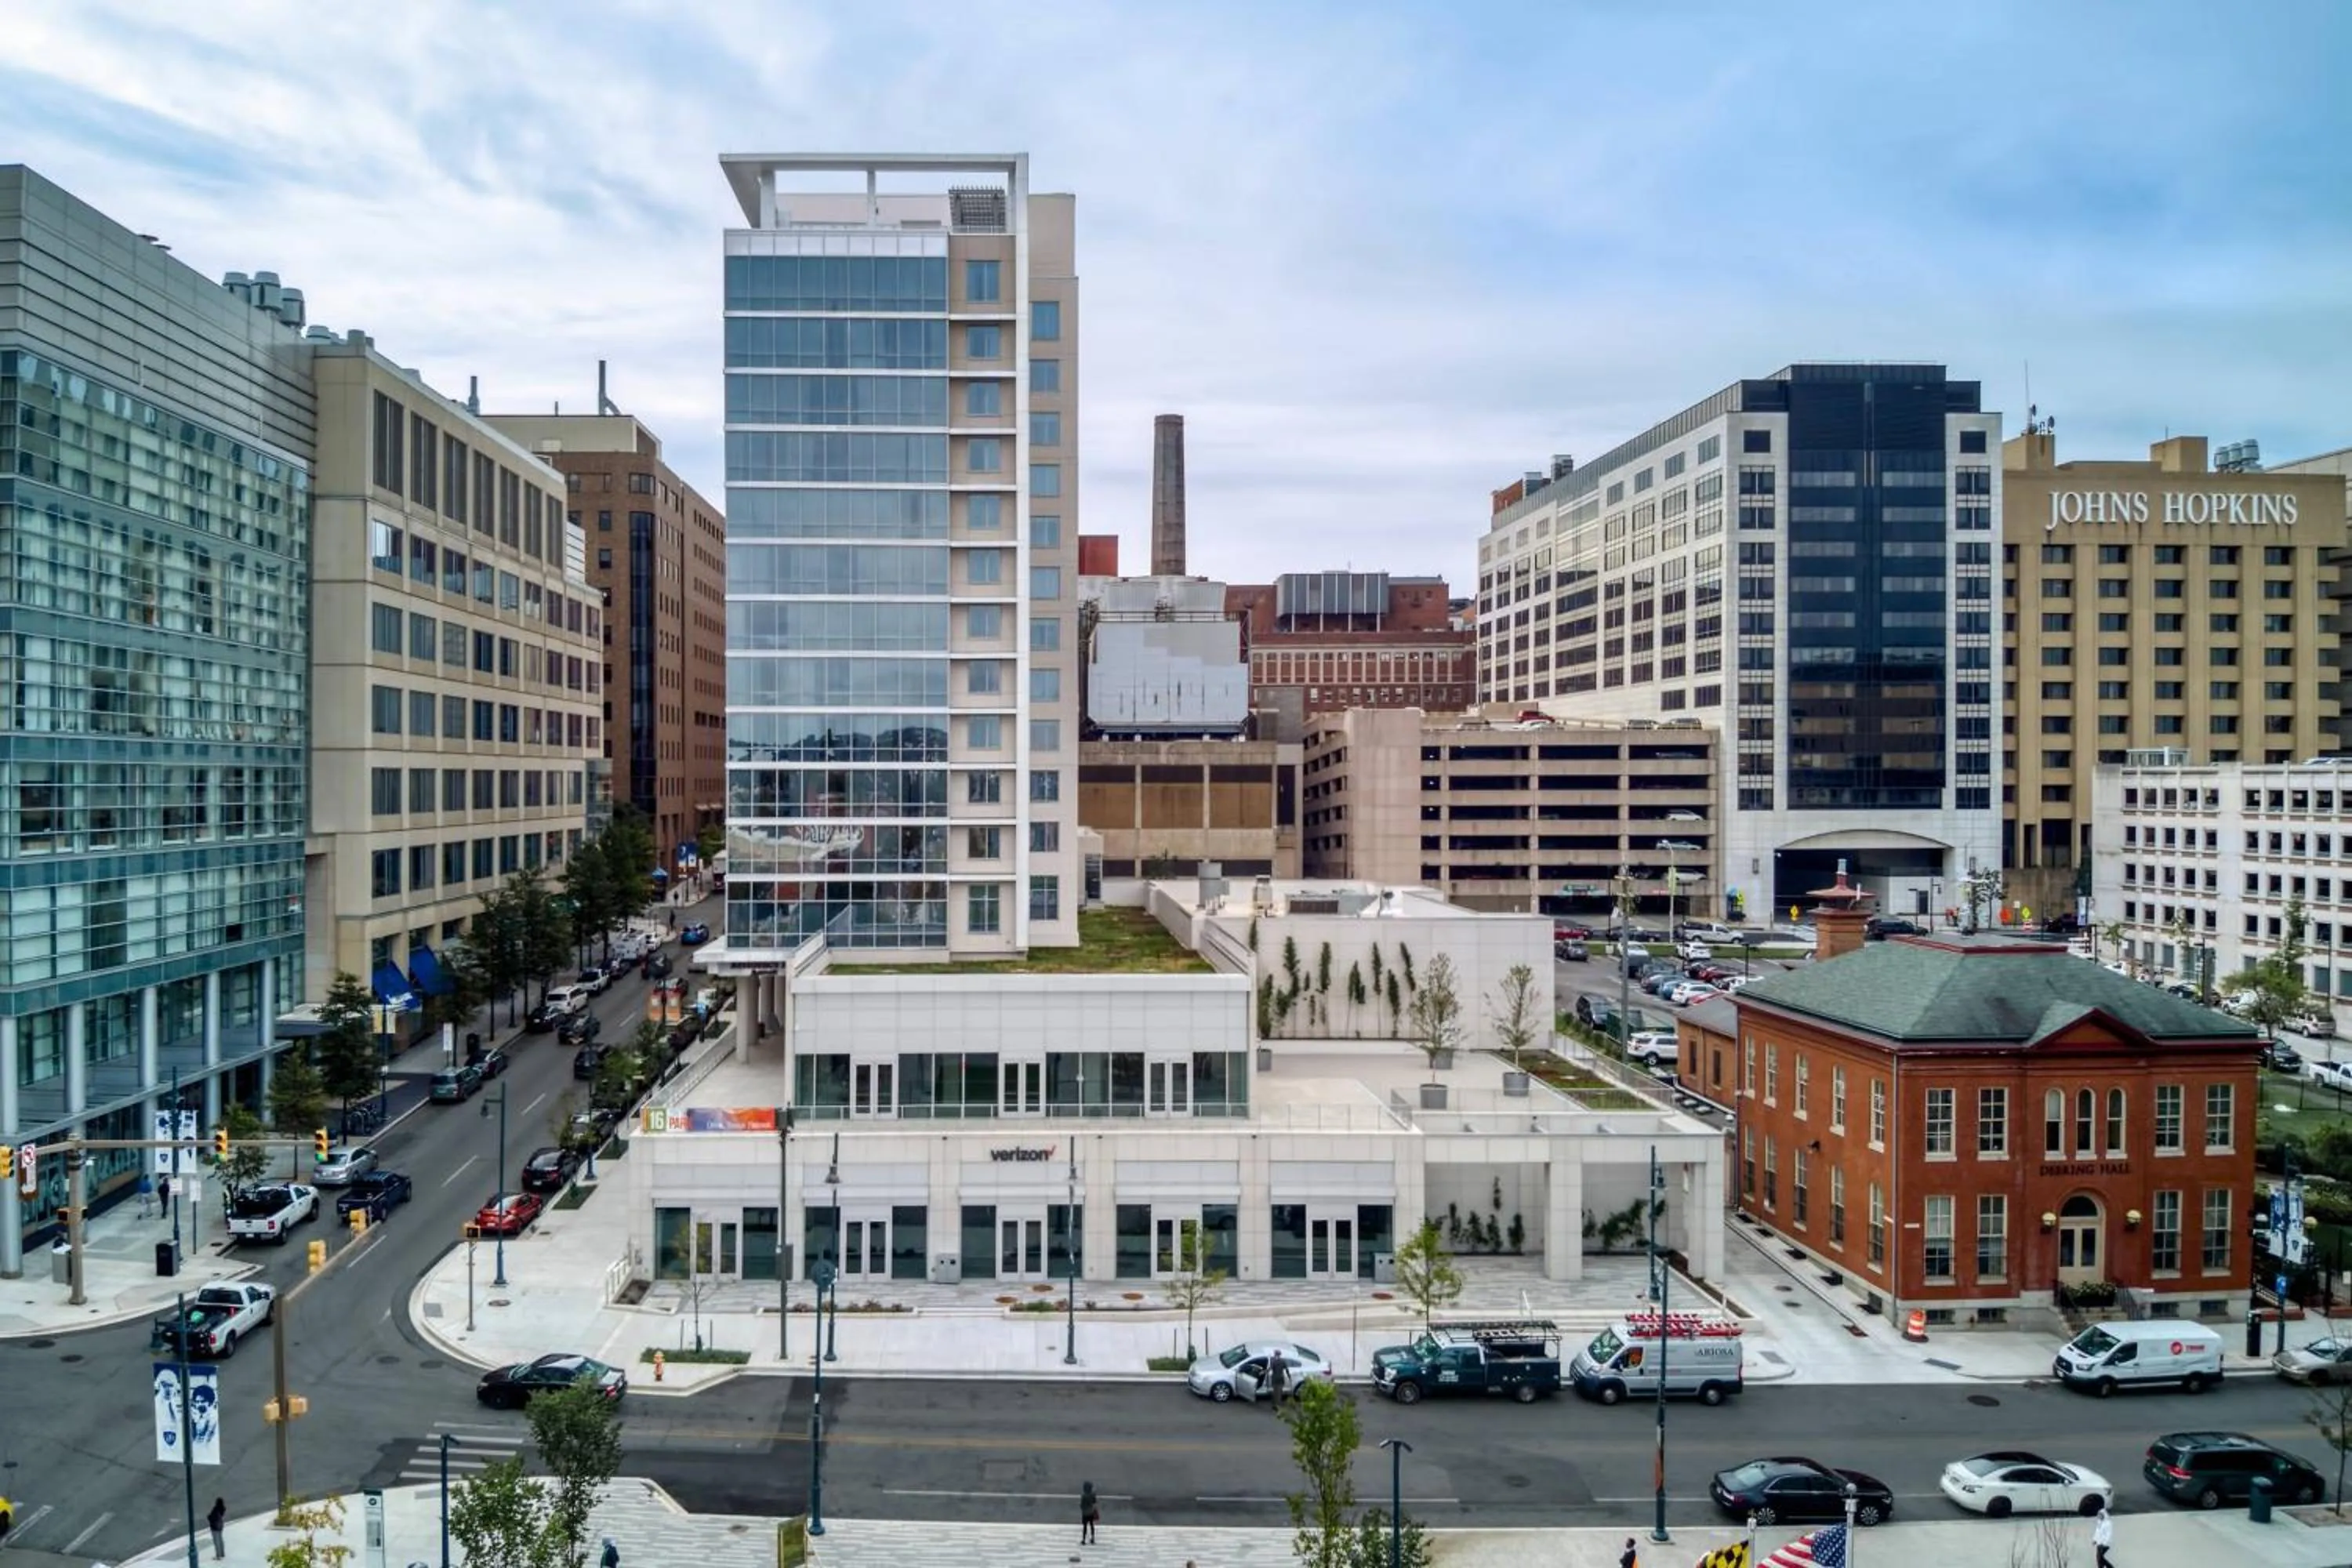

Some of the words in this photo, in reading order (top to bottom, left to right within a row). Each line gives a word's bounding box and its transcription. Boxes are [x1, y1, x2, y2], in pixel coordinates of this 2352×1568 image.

[2046, 492, 2148, 530] JOHNS
[2163, 492, 2298, 524] HOPKINS
[651, 1111, 663, 1129] 16
[990, 1145, 1051, 1161] verizon
[2100, 1163, 2131, 1174] HALL
